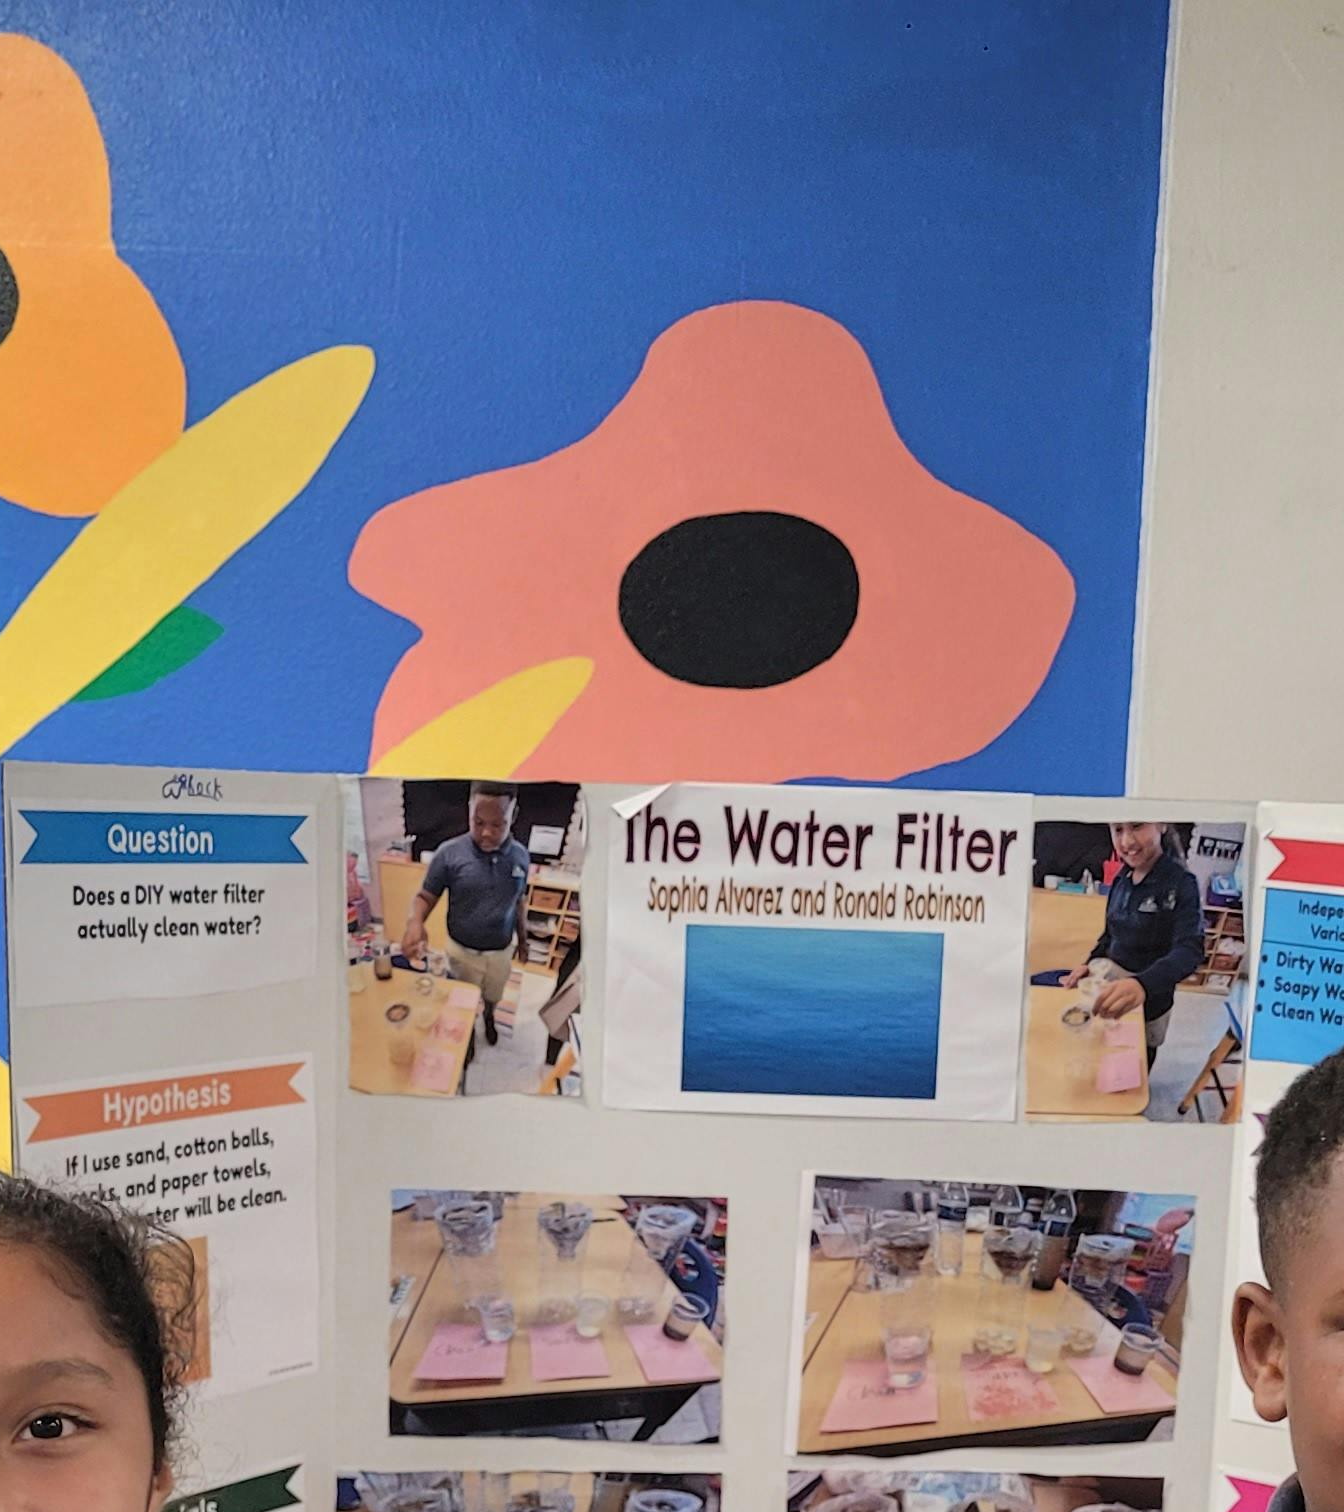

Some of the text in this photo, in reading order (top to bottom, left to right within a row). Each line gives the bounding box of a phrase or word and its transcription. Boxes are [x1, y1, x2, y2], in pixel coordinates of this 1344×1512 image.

[107, 823, 213, 855] Question
[626, 802, 1017, 876] The Water Filter
[73, 884, 265, 905] Does a DIY water filter
[647, 875, 985, 923] Sophia Alvarez and Ronald Robinson
[78, 915, 261, 943] actually clean water?
[1276, 952, 1315, 976] Dirty
[1274, 977, 1320, 1001] Soapy
[1271, 1002, 1315, 1022] Clean
[103, 1078, 231, 1126] Hypothesis
[66, 1128, 274, 1176] If I use sand, cotton balls,
[126, 1176, 156, 1198] and
[162, 1170, 209, 1199] paper
[213, 1158, 271, 1183] towels,
[185, 1197, 212, 1218] will
[218, 1195, 236, 1212] be
[241, 1188, 287, 1209] clean.
